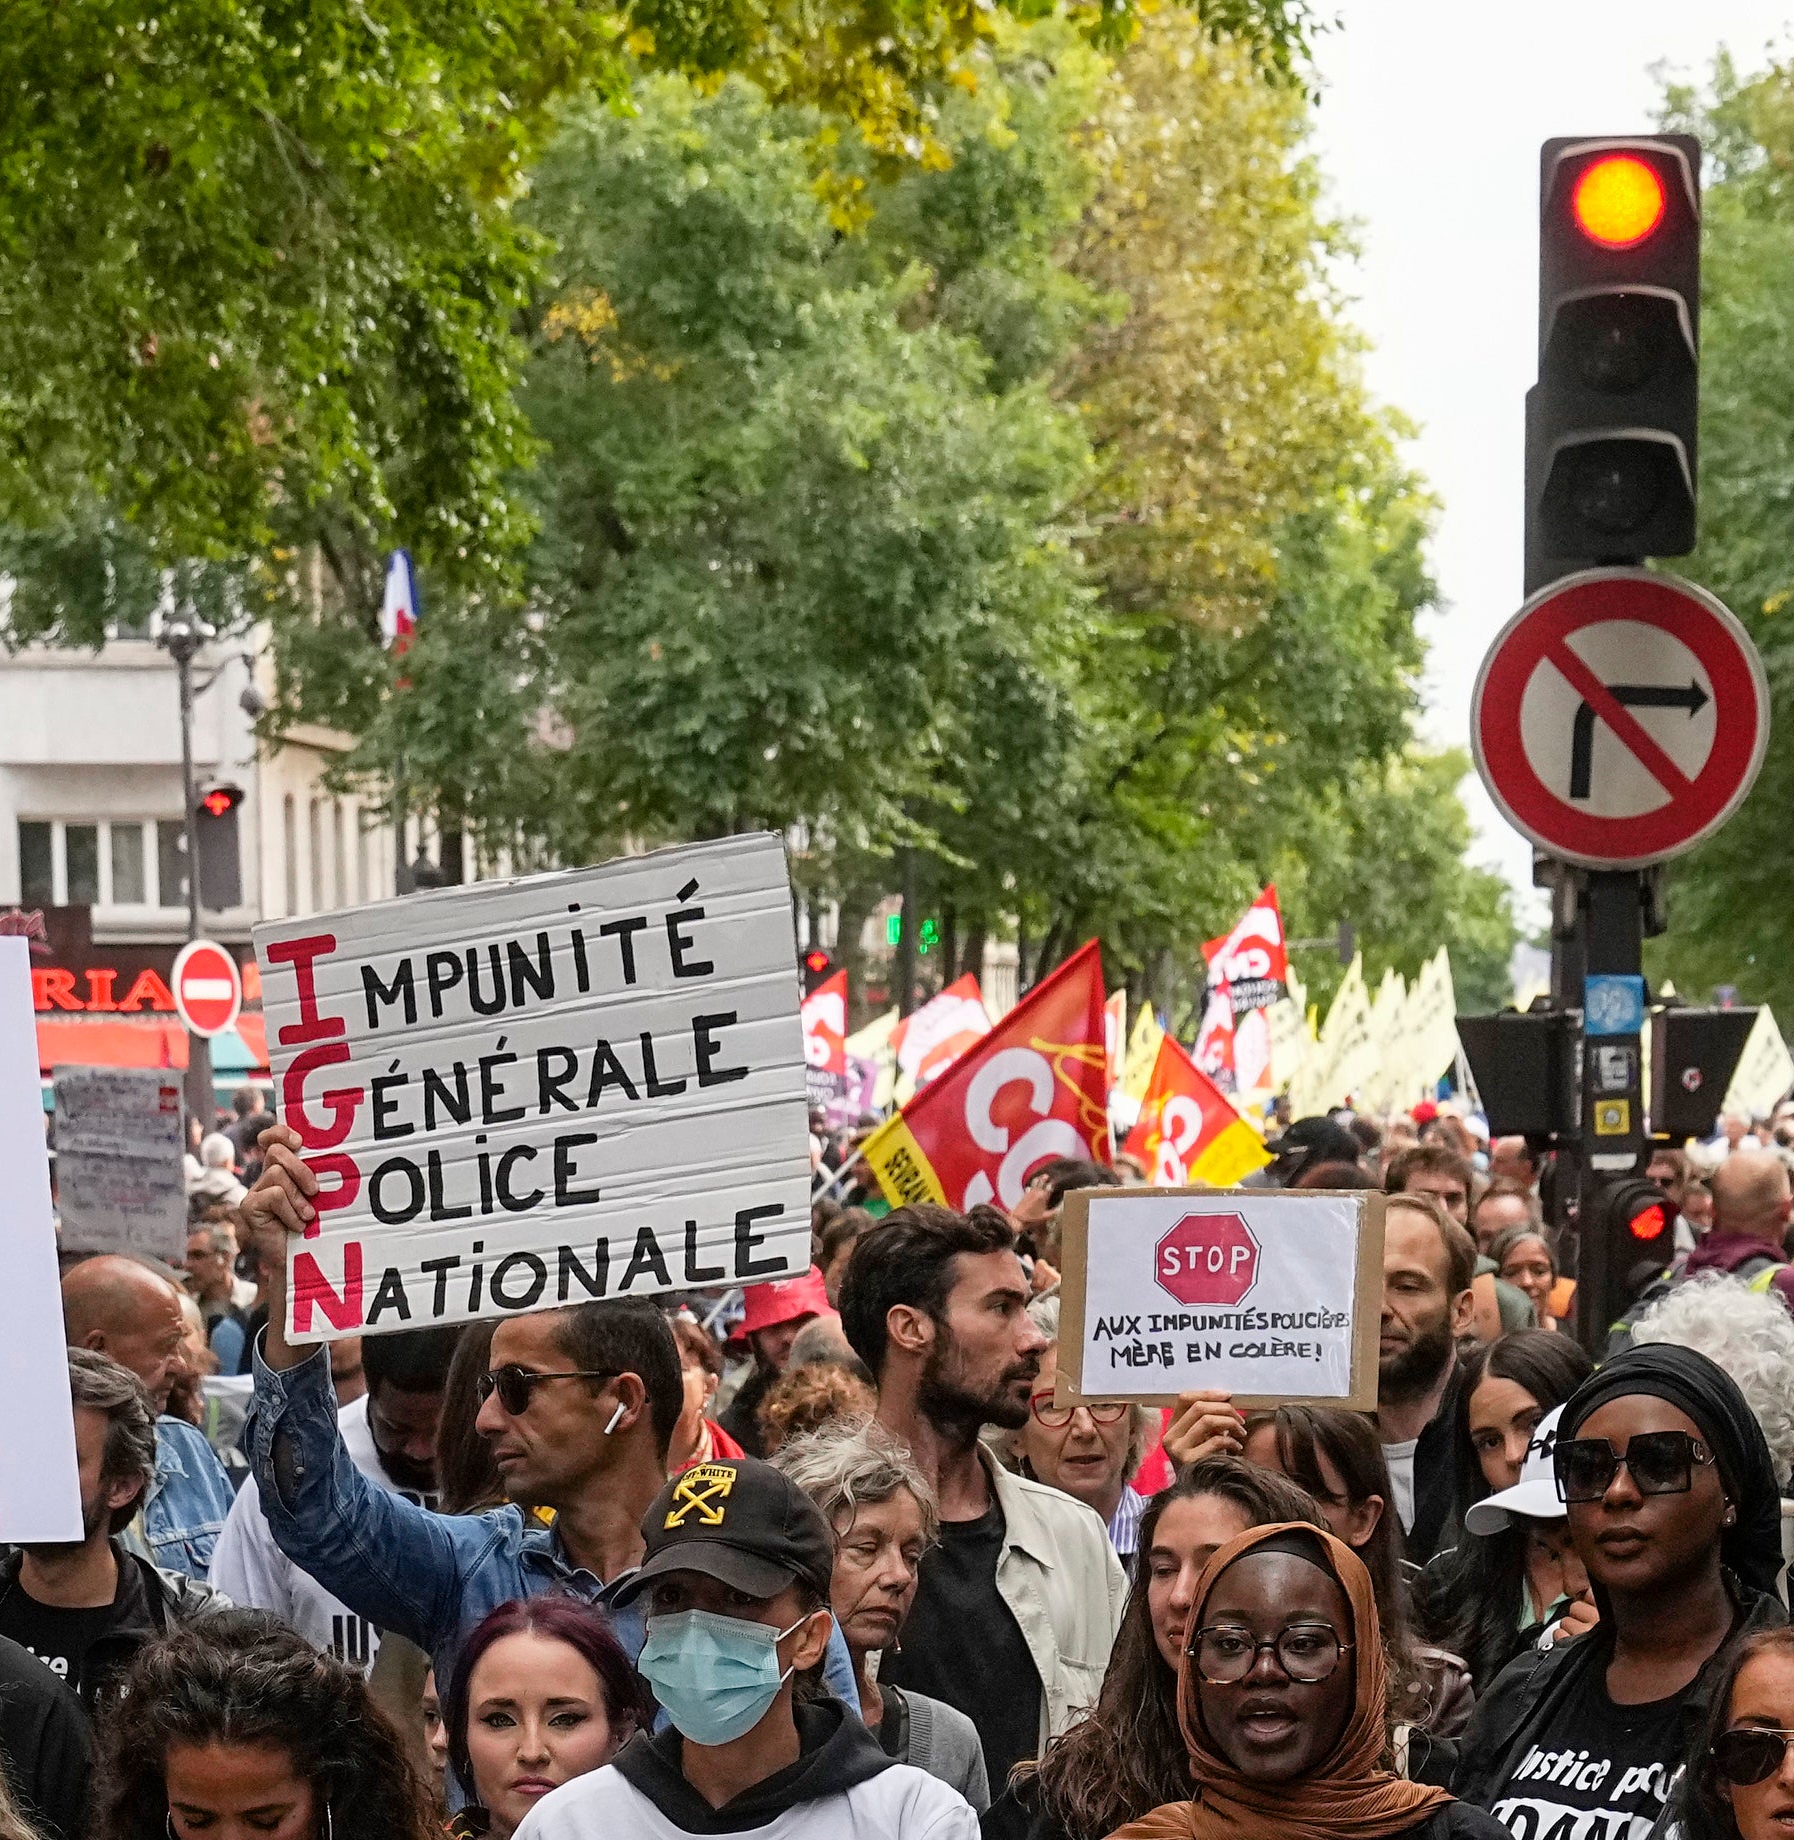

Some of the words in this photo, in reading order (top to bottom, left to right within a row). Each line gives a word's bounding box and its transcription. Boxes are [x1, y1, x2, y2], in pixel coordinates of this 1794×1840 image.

[284, 1010, 749, 1150] GÉNÉRALE
[1162, 1246, 1251, 1276] STOP
[1093, 1314, 1142, 1341] AUX
[1110, 1338, 1174, 1370] MÈRE
[1187, 1341, 1222, 1363] EN
